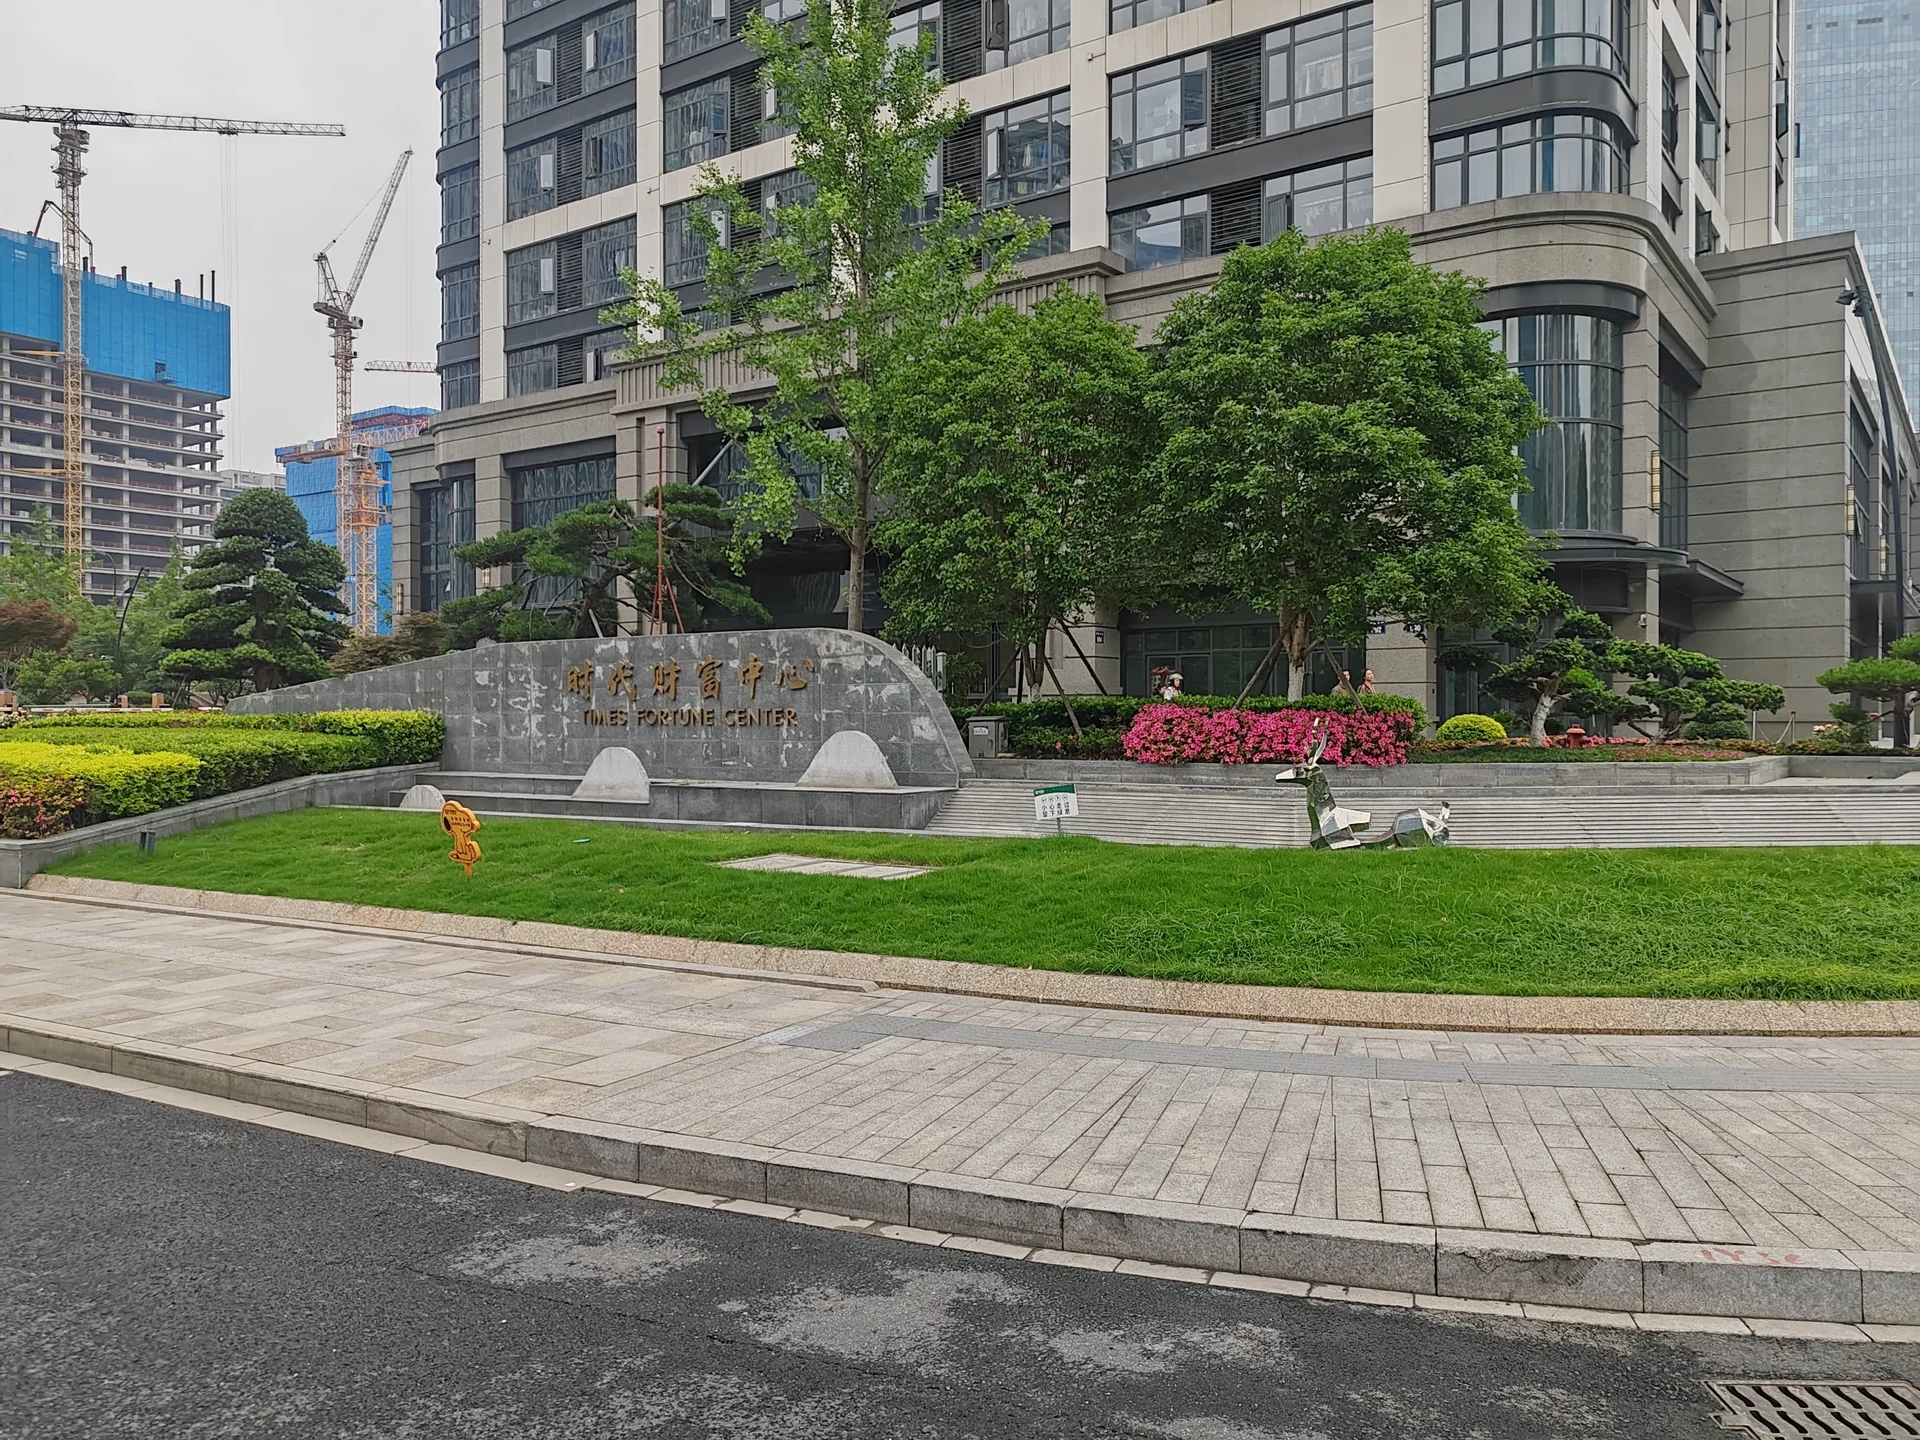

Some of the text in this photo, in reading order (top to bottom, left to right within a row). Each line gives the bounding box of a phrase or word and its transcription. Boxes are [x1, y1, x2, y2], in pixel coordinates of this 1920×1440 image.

[568, 652, 815, 701] 时代财富中心
[582, 707, 798, 727] TIMES FORTUNE CENTER
